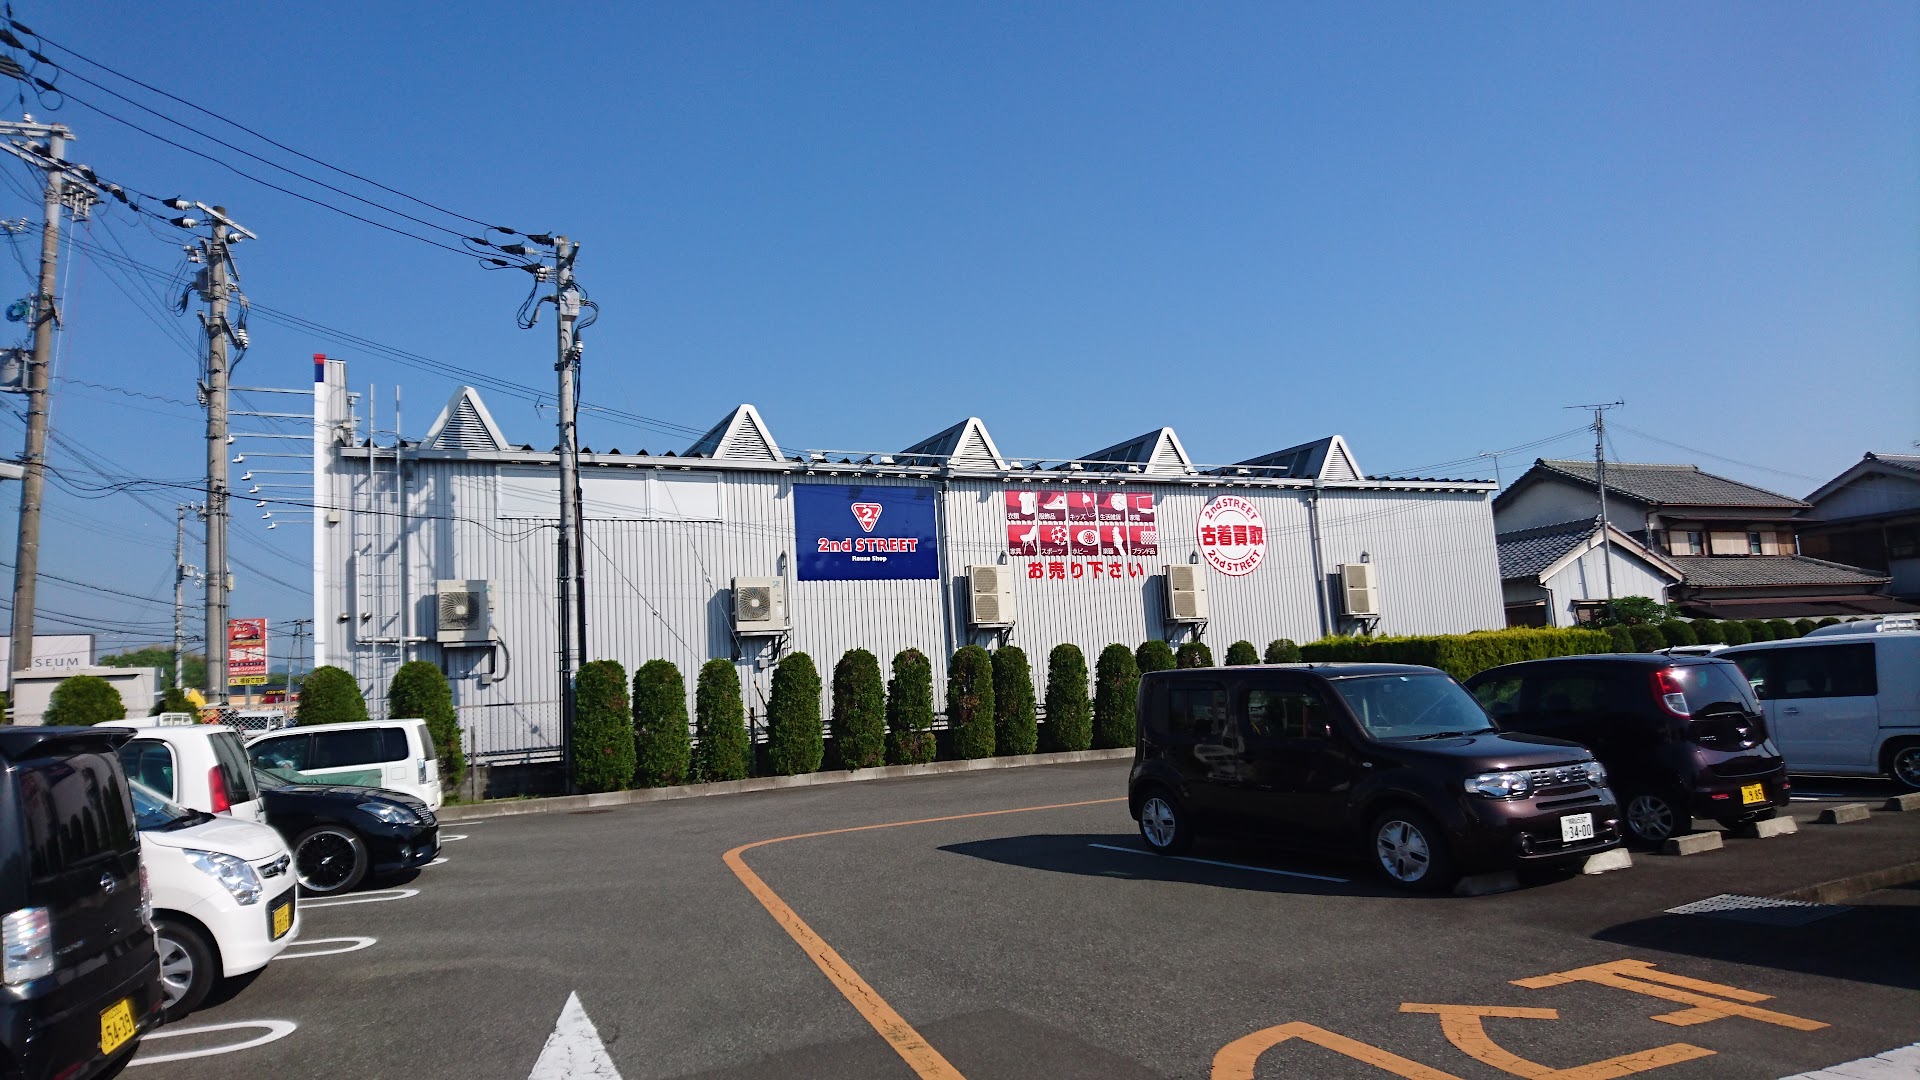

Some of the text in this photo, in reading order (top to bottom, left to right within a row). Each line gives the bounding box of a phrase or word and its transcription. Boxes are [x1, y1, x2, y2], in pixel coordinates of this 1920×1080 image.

[1204, 498, 1258, 520] 2nd STREET
[1201, 524, 1264, 546] 古着買取
[818, 537, 918, 553] 2nd STREET
[871, 555, 887, 563] Shop
[1207, 549, 1262, 572] 2nd STREET
[1027, 561, 1144, 580] お売り下さい
[229, 646, 265, 661] 車検
[34, 657, 79, 668] SEUM
